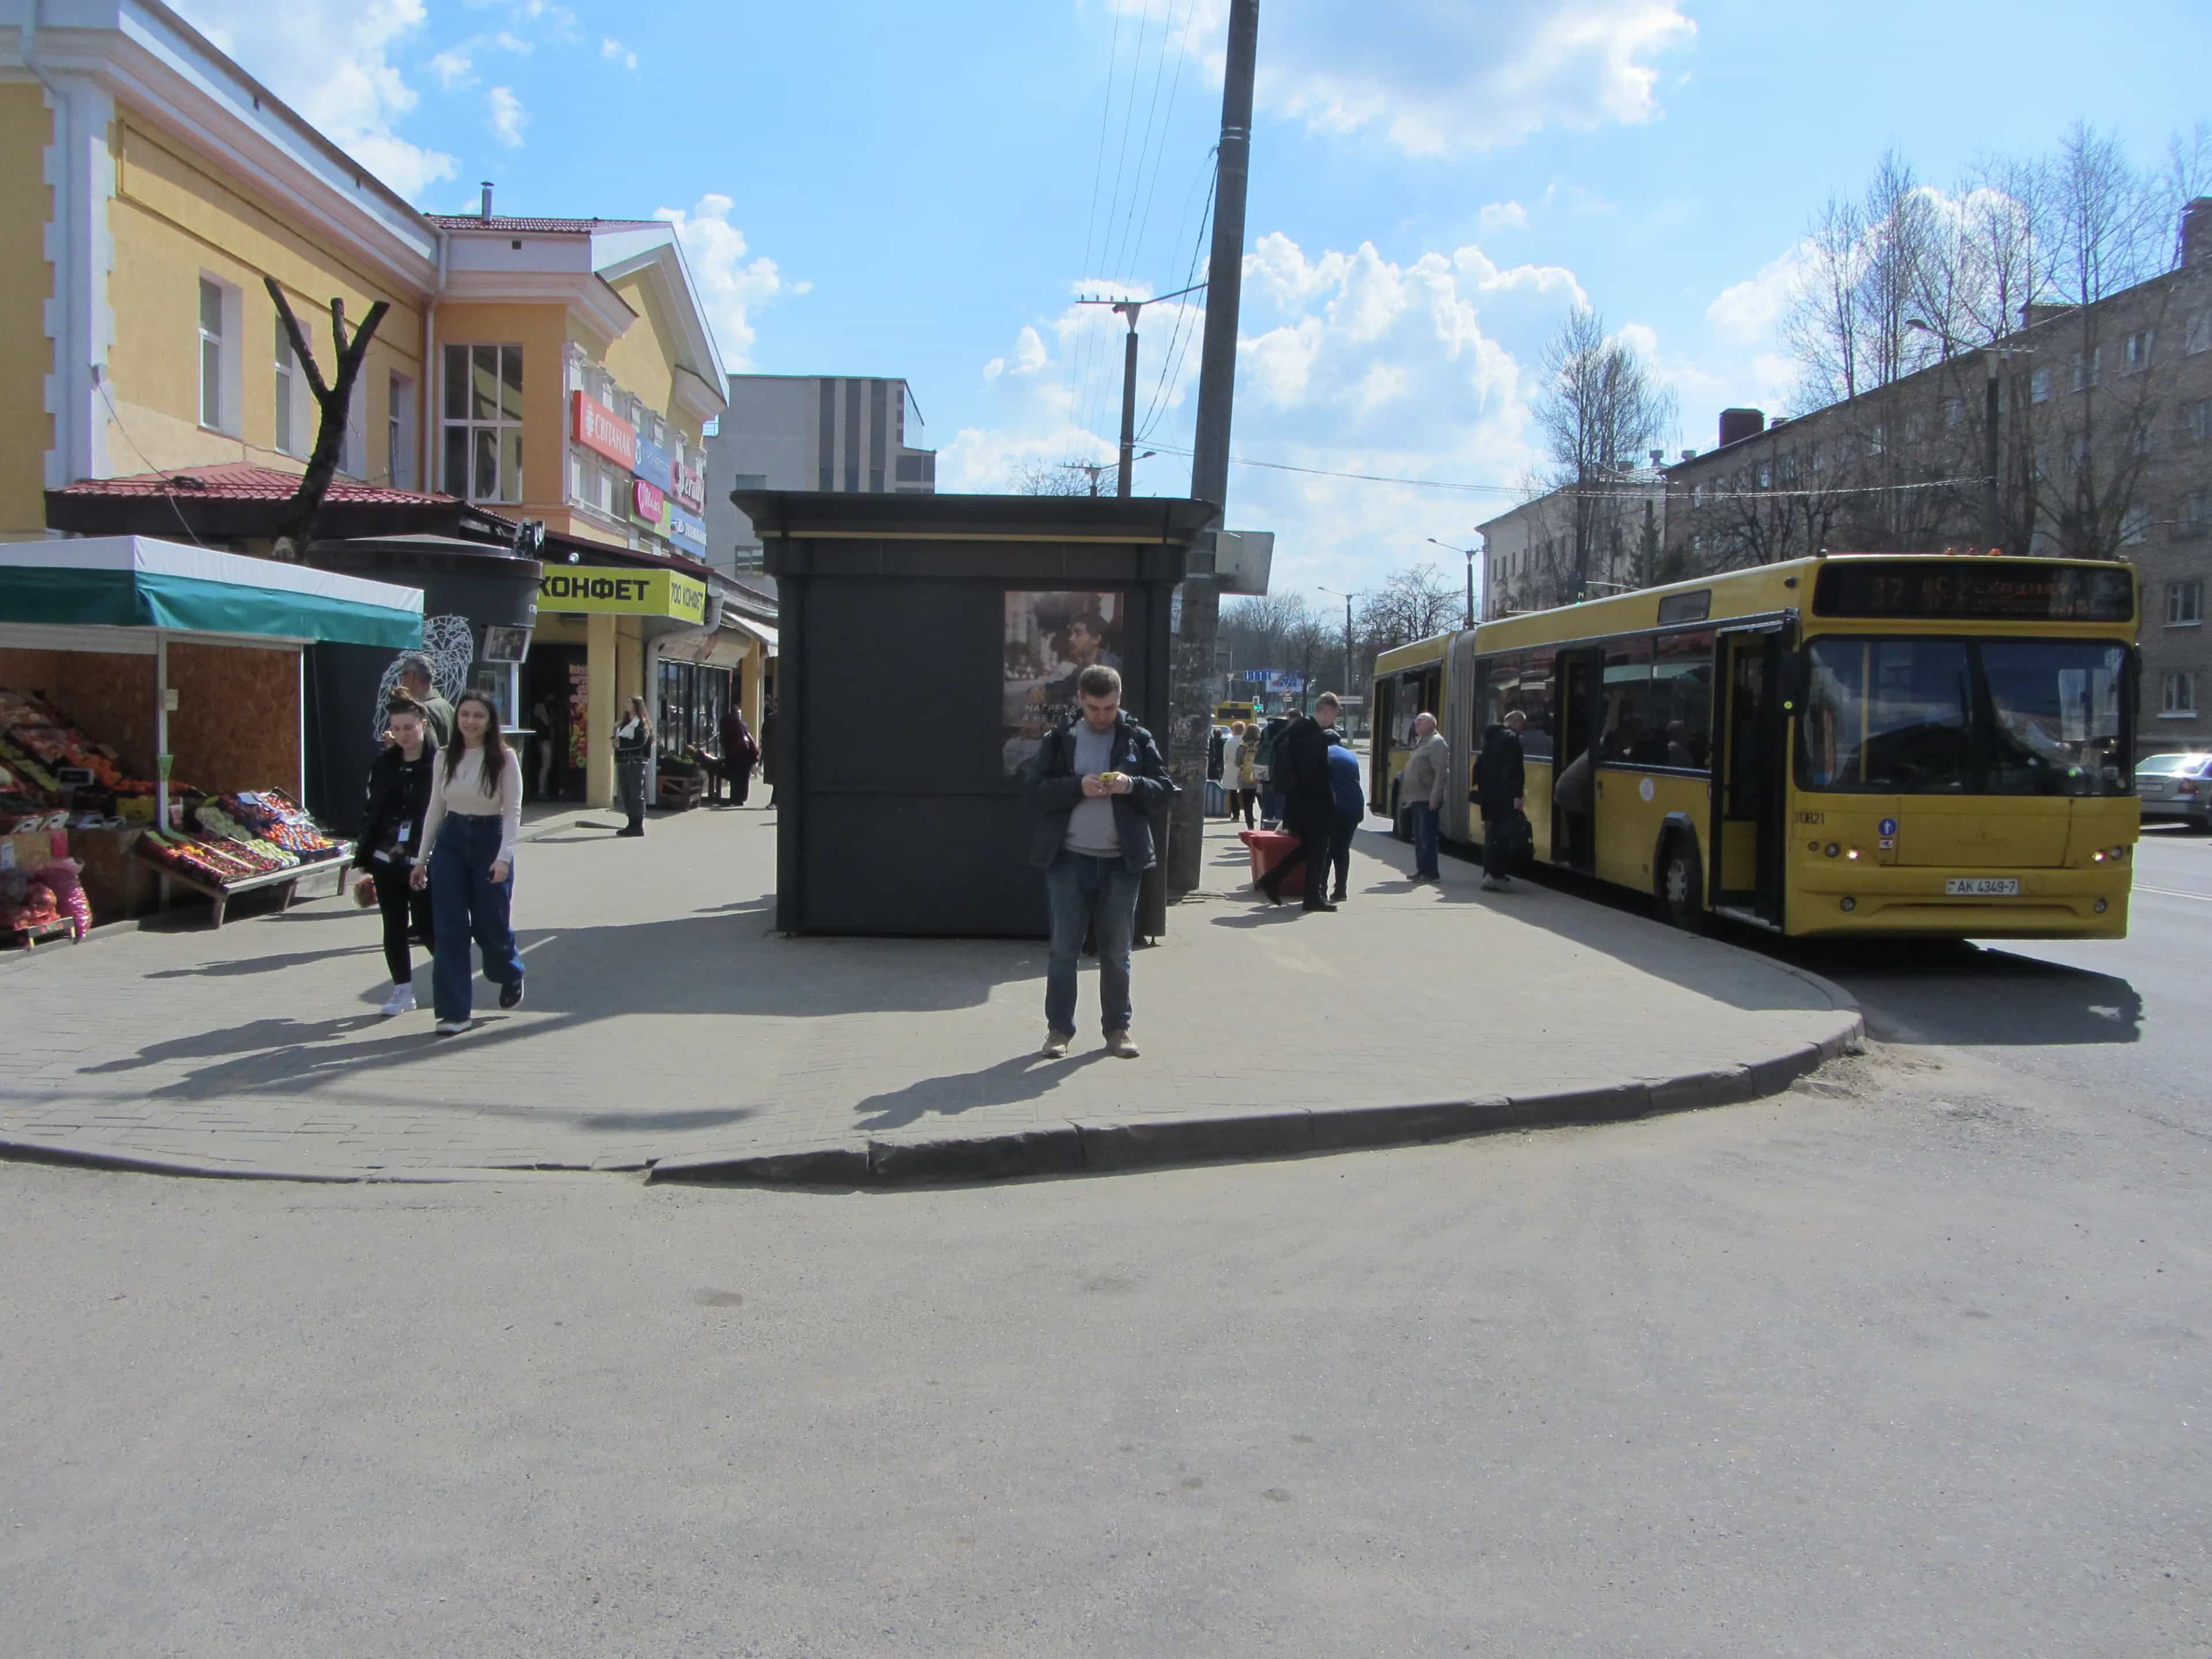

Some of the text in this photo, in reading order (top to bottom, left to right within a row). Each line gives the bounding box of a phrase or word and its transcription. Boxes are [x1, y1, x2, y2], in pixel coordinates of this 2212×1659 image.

[594, 414, 632, 458] СВІТАНАК
[539, 576, 650, 601] КОНФЕТ
[1958, 881, 2016, 893] AK 4349-7
